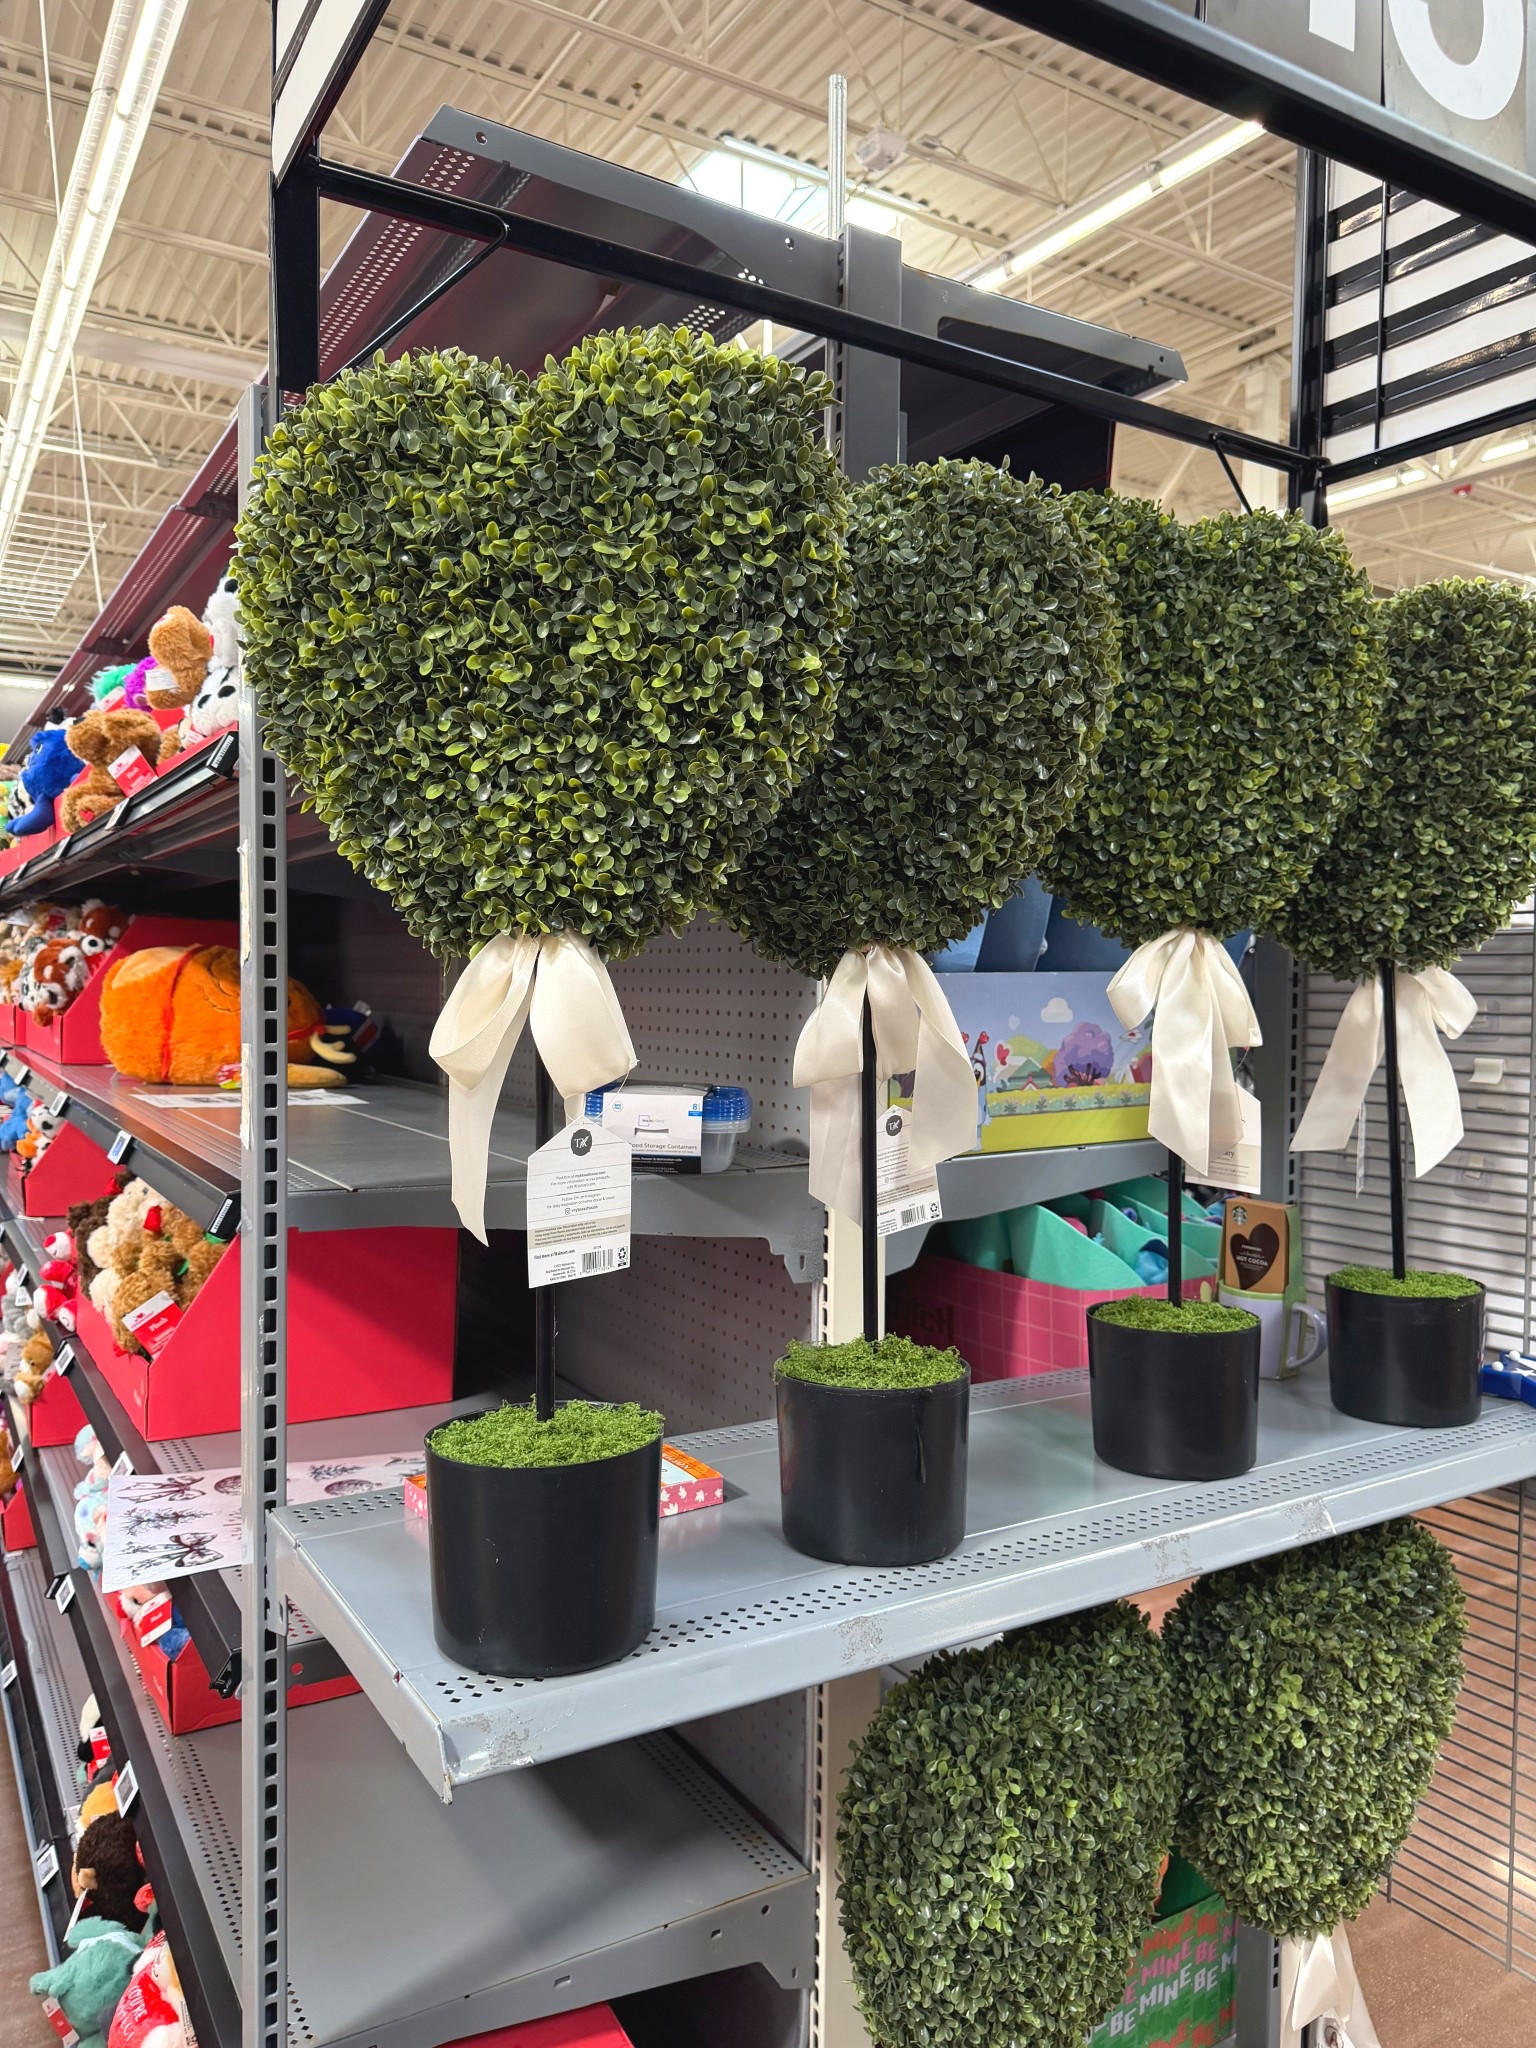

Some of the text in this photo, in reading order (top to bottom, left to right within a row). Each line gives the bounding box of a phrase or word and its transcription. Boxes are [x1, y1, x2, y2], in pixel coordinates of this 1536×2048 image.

[644, 1142, 666, 1150] Storage
[1247, 1257, 1268, 1266] COCOA
[1142, 1909, 1196, 1958] MINE
[1197, 1912, 1219, 1937] BE
[1141, 1936, 1193, 1987] MINE
[1195, 1939, 1219, 1965] BE
[1110, 2007, 1136, 2037] BE
[1139, 1963, 1192, 2015] MINE
[1194, 1965, 1219, 1994] BE
